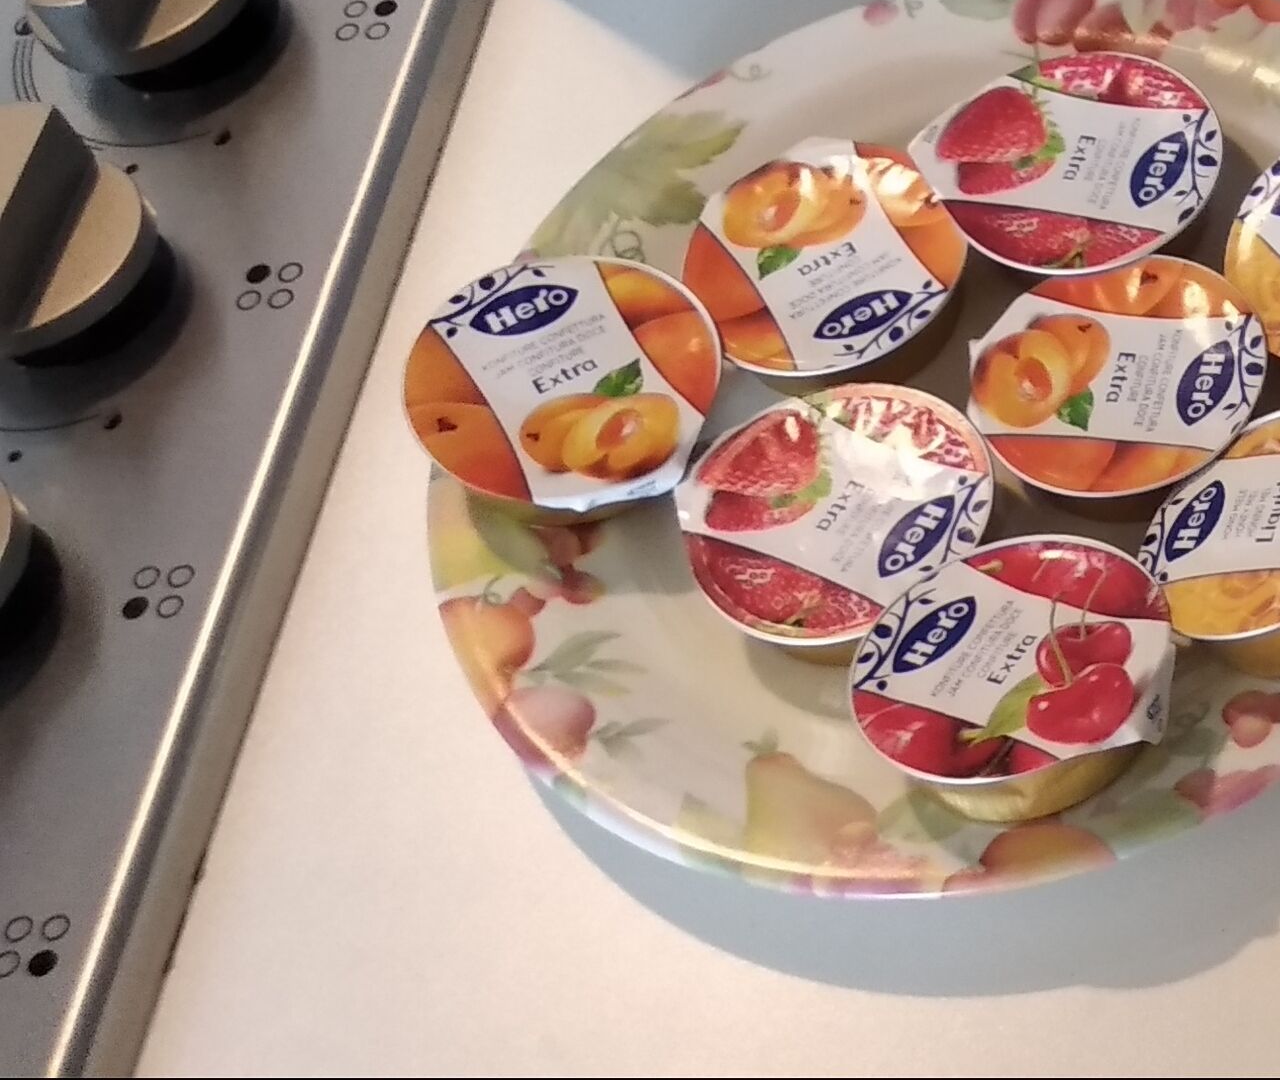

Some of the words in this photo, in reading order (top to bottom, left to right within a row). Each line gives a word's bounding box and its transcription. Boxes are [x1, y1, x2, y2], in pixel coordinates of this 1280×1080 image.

[1062, 134, 1096, 180] Extra
[1138, 141, 1177, 202] Hero
[797, 241, 856, 276] Extra
[485, 288, 569, 333] Hero
[821, 292, 902, 338] Hero
[531, 359, 597, 394] Extra
[1105, 351, 1136, 402] Extra
[1187, 351, 1223, 418] Hero
[815, 480, 863, 531] Extra
[1173, 484, 1219, 552] Hero
[885, 503, 947, 572] Hero
[903, 602, 970, 667] Hero
[986, 634, 1037, 684] Extra
